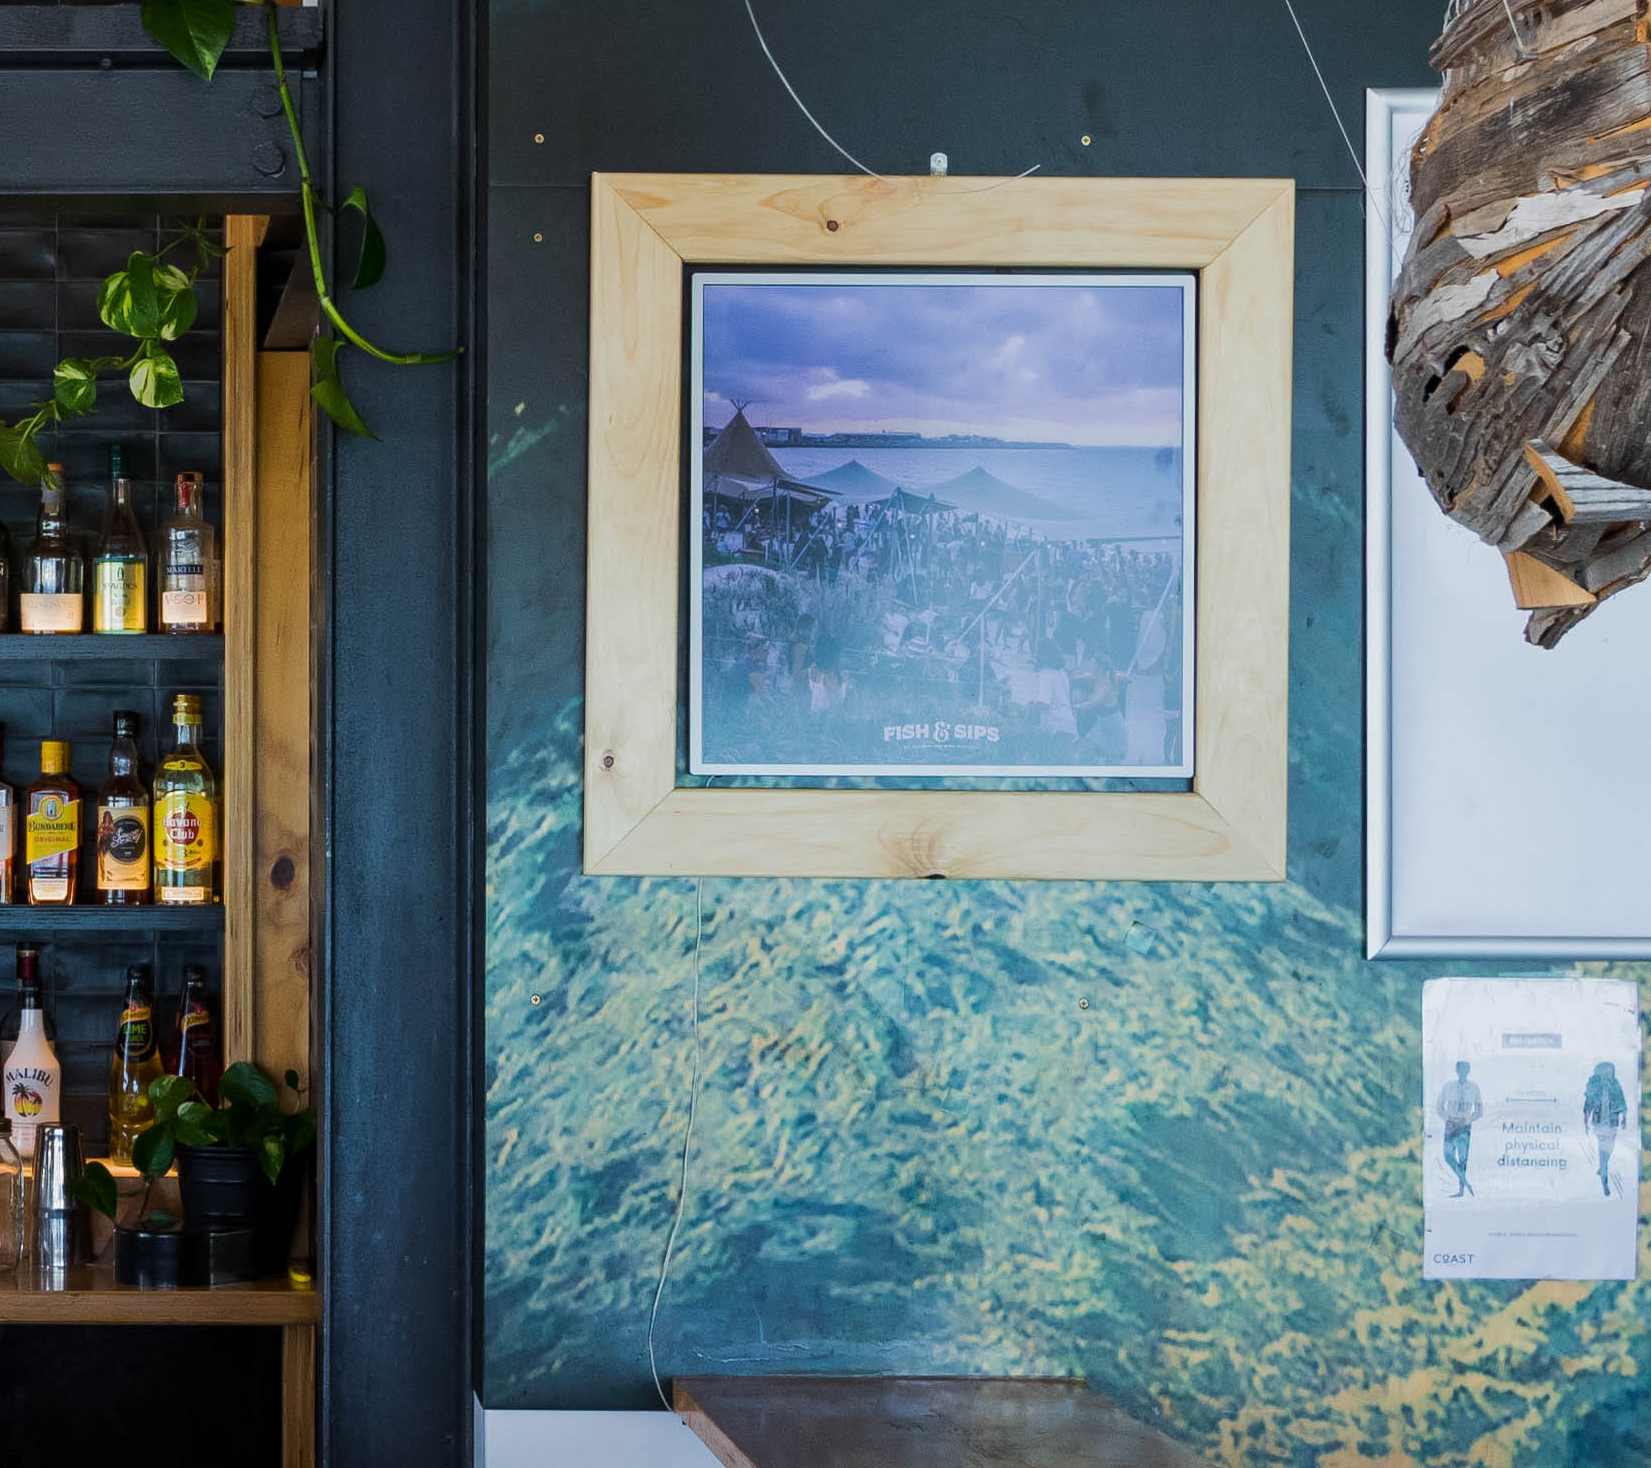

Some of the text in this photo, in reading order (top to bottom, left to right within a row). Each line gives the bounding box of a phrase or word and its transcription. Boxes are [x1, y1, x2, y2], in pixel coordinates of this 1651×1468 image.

[884, 720, 1000, 742] FISH & SIPS
[162, 816, 202, 829] Havana
[34, 835, 70, 843] ORIGINAL
[170, 828, 194, 840] Club
[5, 1067, 54, 1089] MALIBU
[1502, 1122, 1562, 1133] Maintain
[1505, 1137, 1560, 1153] physical
[1497, 1154, 1567, 1171] distancing
[1433, 1252, 1474, 1264] COAST
